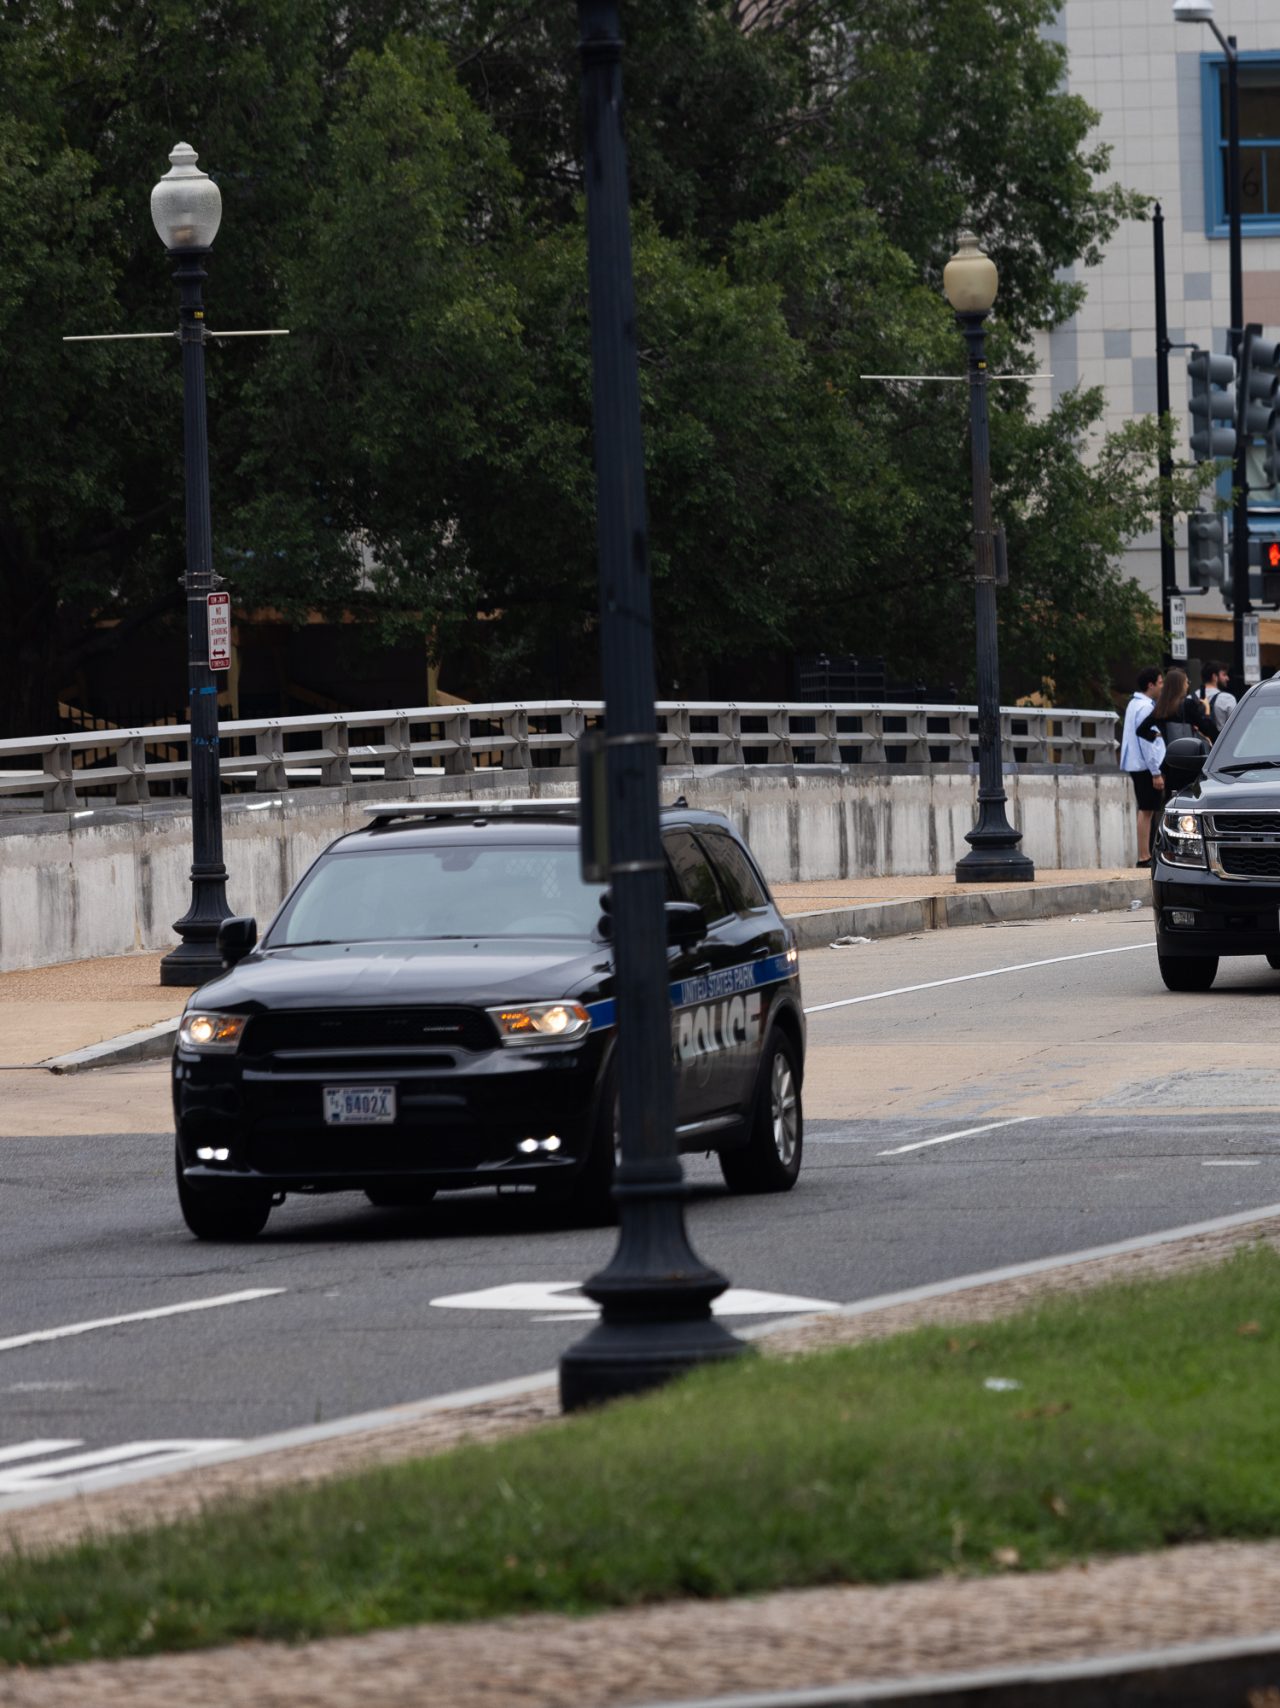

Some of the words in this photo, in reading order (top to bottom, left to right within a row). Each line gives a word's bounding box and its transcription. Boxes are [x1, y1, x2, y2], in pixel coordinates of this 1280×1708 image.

[681, 977, 708, 1004] UNITED
[708, 971, 734, 997] STATES
[734, 965, 756, 991] PARK
[679, 992, 762, 1059] POLICE
[345, 1095, 389, 1114] 6402X
